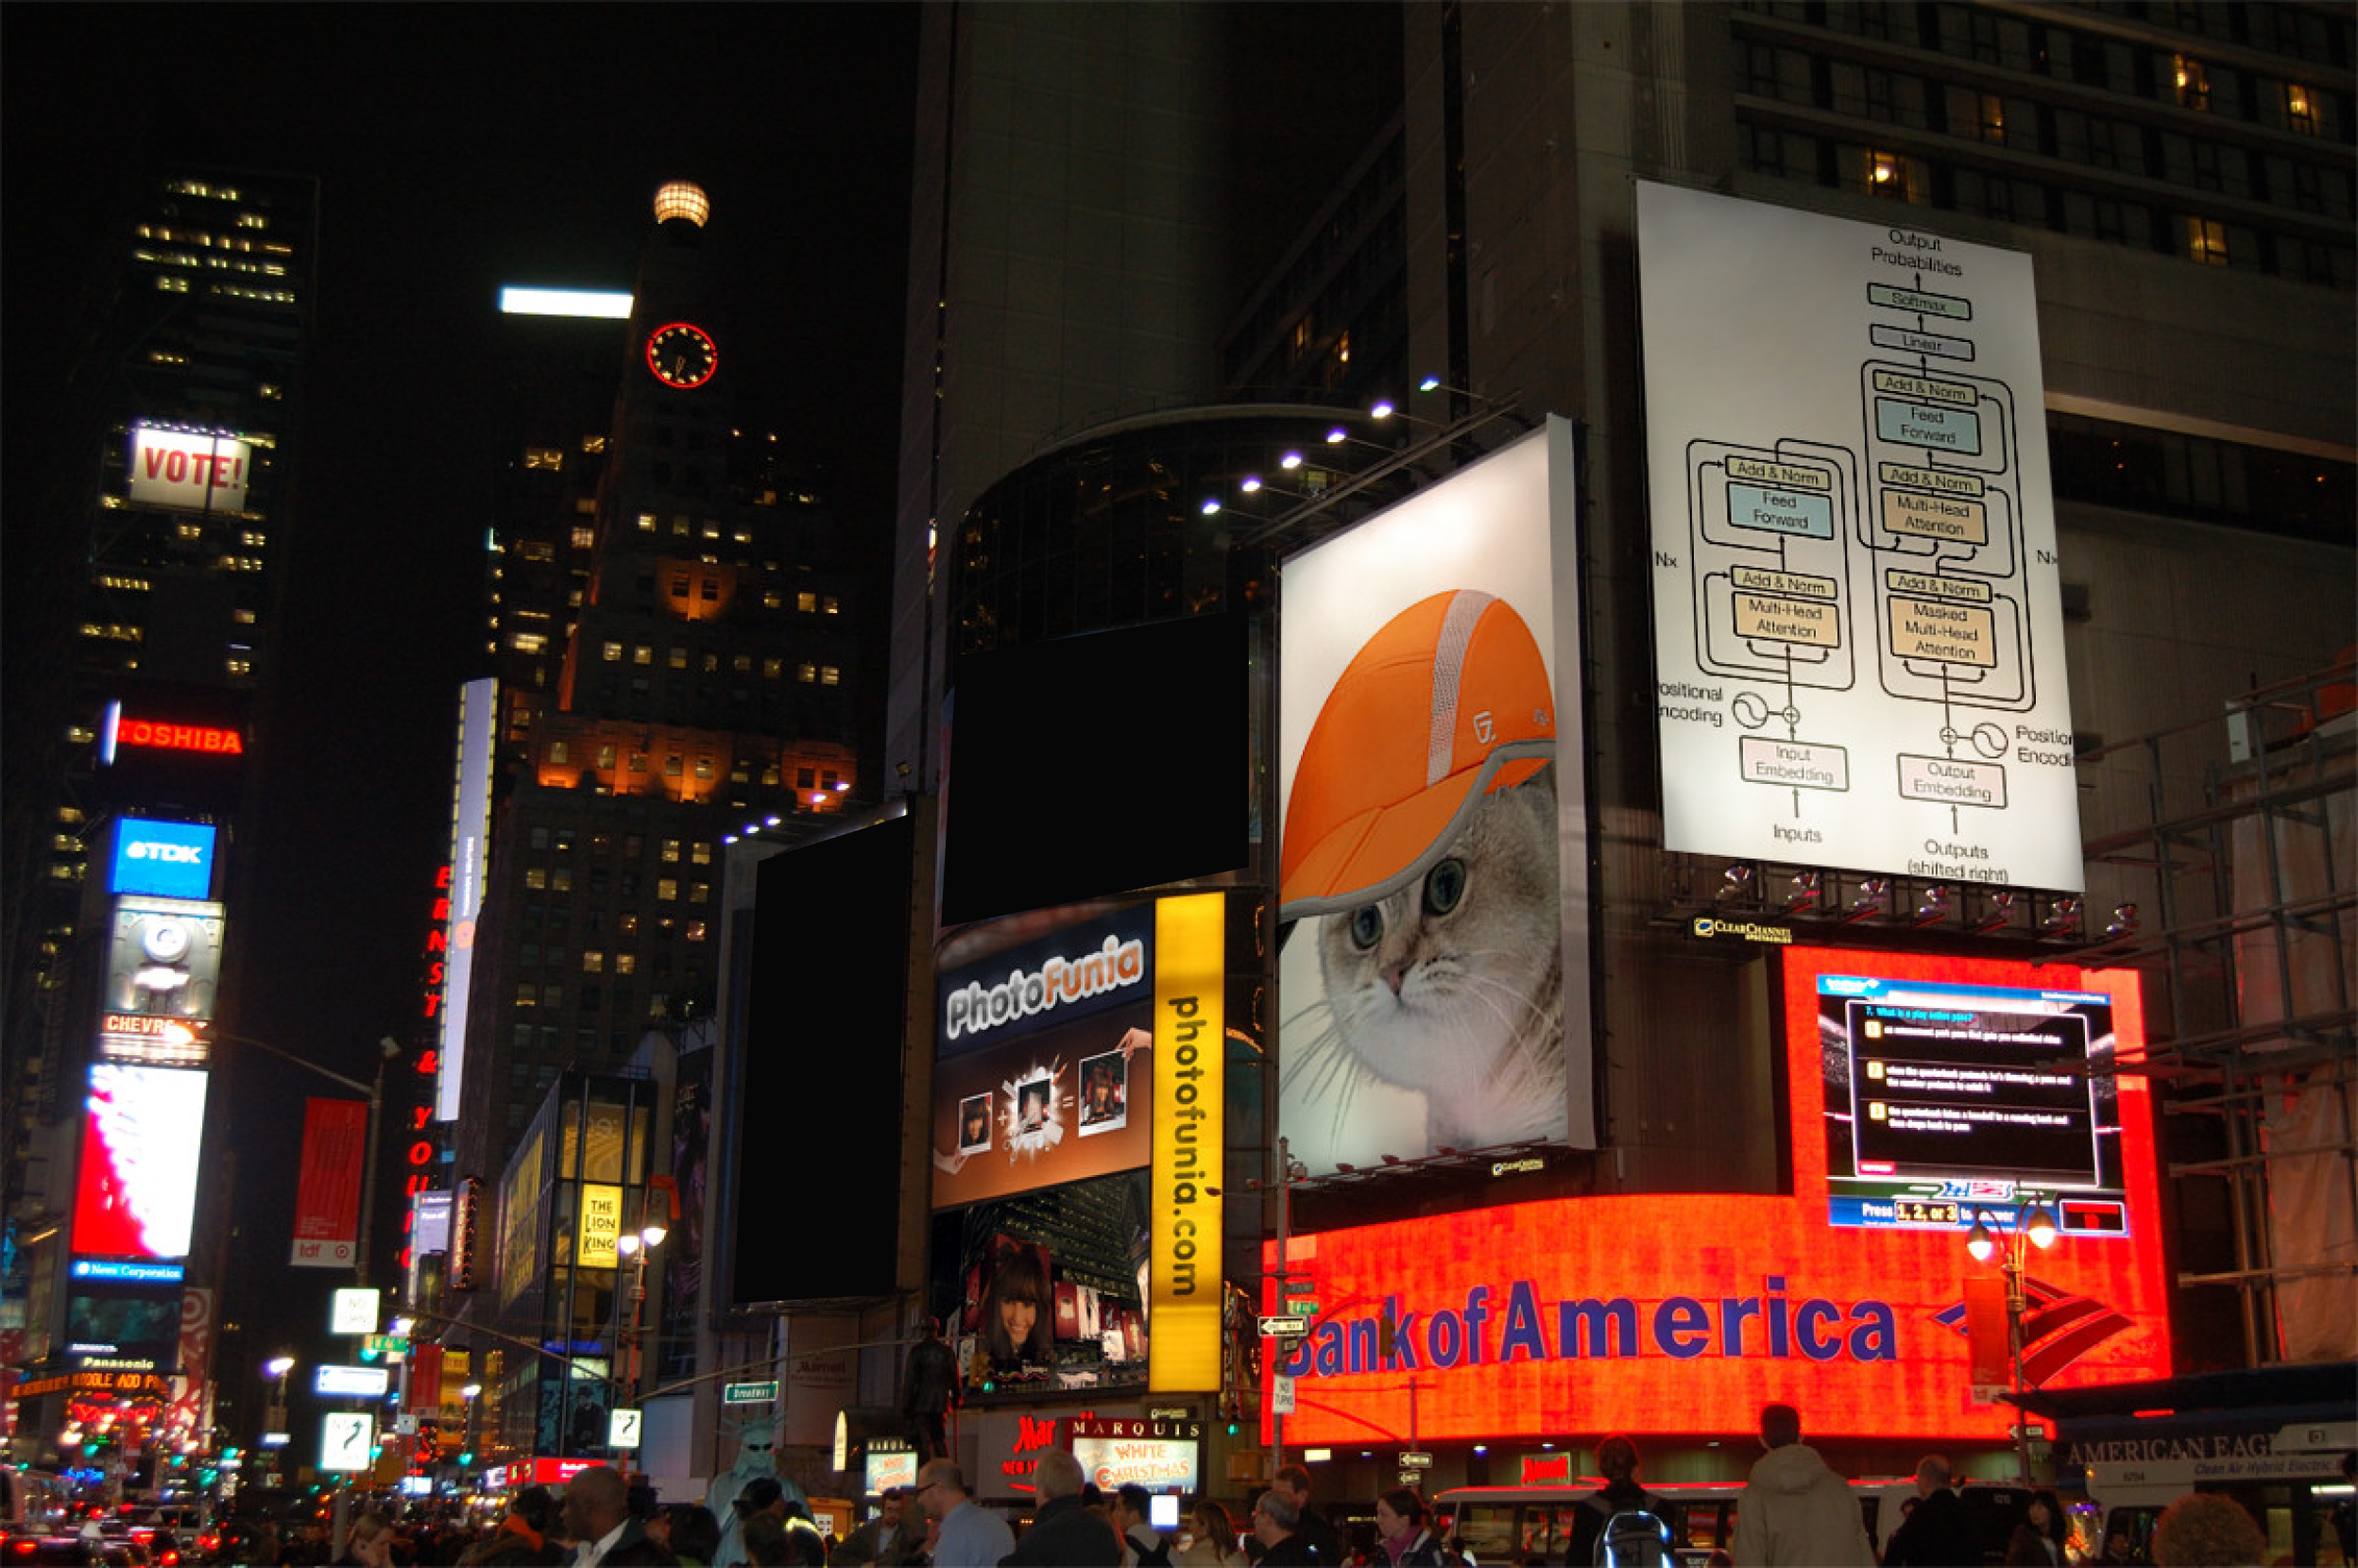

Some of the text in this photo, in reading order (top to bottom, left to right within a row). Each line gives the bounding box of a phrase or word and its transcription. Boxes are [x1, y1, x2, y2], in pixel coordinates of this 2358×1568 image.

[1889, 229, 1941, 252] Output
[1871, 247, 1962, 277] Probabilities
[1891, 291, 1947, 314] Softmax
[1903, 333, 1942, 352] Linear
[1884, 376, 1966, 401] Add & Norm
[1911, 406, 1944, 424] Feed
[1901, 423, 1956, 446] Forward
[145, 447, 242, 489] VOTE!
[1736, 460, 1819, 486] Add & Norm
[1889, 468, 1974, 493] Add & Norm
[1763, 492, 1796, 509] Feed
[1897, 494, 1970, 519] Multi-Head
[1752, 508, 1809, 529] Forward
[1905, 515, 1964, 537] Attention
[1742, 571, 1826, 595] Add & Norm
[1898, 573, 1981, 599] Add & Norm
[1748, 599, 1822, 622] Multi-Head
[1913, 603, 1967, 622] Masked
[1756, 618, 1817, 639] Attention
[1905, 621, 1978, 643] Multi-Head
[1915, 639, 1976, 660] Attention
[1659, 681, 1722, 702] ositional
[1659, 706, 1722, 727] ncoding
[1775, 744, 1811, 763] Input
[2018, 746, 2075, 768] Encodi
[1755, 761, 1835, 785] Embedding
[1927, 761, 1975, 782] Output
[1913, 779, 1992, 803] Embedding
[1773, 823, 1822, 844] Inputs
[147, 842, 202, 863] TDK
[1924, 839, 1989, 861] Outputs
[1907, 860, 2009, 885] (shifted right)
[947, 934, 1145, 1040] PhotoFunia
[1169, 996, 1207, 1297] photofunia.com
[590, 1200, 613, 1212] THE
[1427, 1285, 1489, 1369] of
[1499, 1275, 1897, 1362] America
[1072, 1421, 1200, 1437] MARQUIS
[1115, 1442, 1169, 1460] WHITE
[2066, 1435, 2205, 1465] AMERICAN
